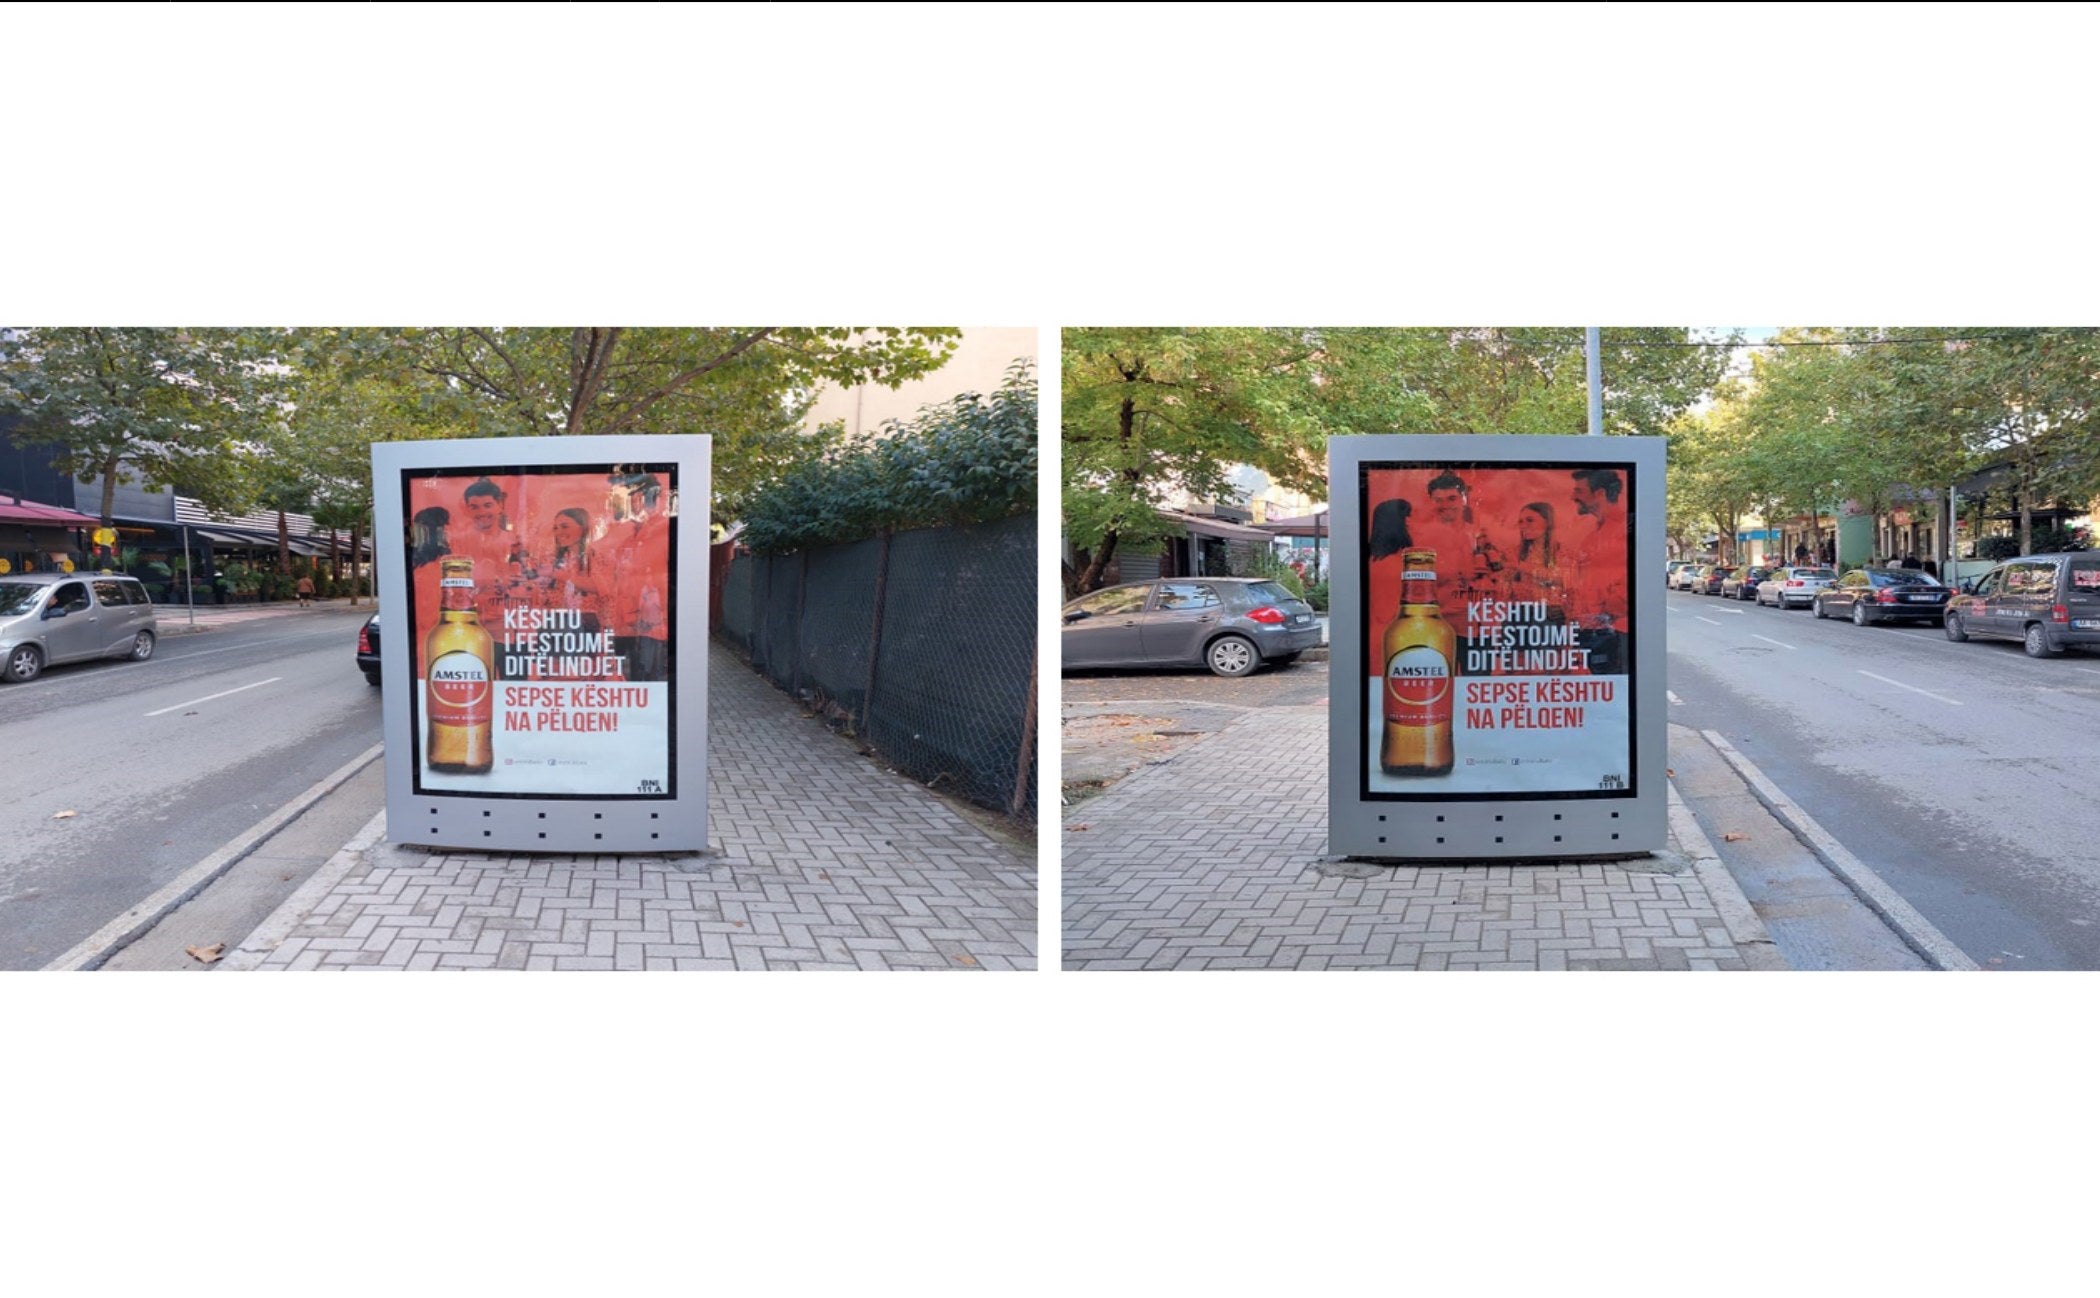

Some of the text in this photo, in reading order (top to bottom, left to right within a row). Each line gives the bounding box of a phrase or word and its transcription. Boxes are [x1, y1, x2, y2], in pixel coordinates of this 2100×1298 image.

[504, 605, 581, 630] KËSHTU
[1467, 598, 1547, 622] KËSHTU
[504, 629, 616, 654] I FESTOJMË
[1467, 622, 1581, 647] I FESTOJMË
[505, 653, 626, 677] DITËLINDJET
[1392, 666, 1444, 677] AMSTEL
[1467, 646, 1592, 672] DITËLINDJET
[434, 670, 484, 680] AMSTEL
[505, 684, 649, 708] SEPSE KËSHTU
[1466, 678, 1614, 704] SEPSE KËSHTU
[505, 708, 619, 733] NA PËLQEN!
[1466, 704, 1584, 730] NA PËLQEN!
